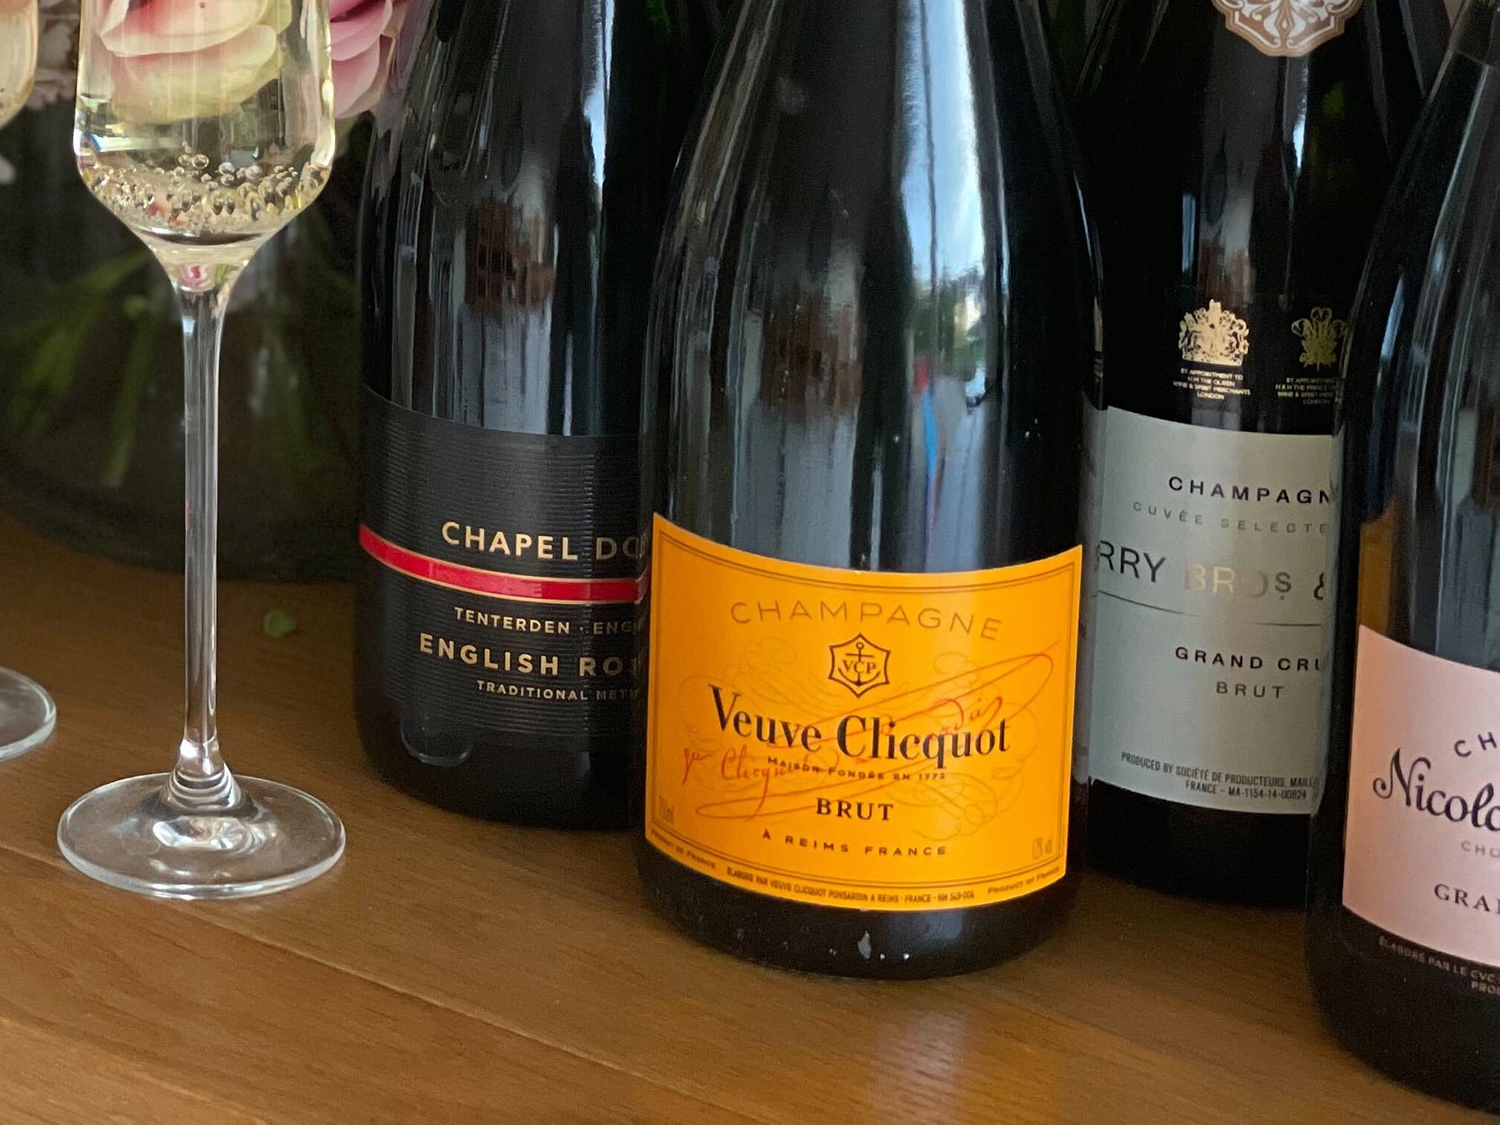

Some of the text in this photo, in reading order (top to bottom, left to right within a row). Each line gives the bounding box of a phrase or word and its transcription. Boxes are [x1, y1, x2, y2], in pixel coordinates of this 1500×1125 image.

[1168, 476, 1330, 504] CHAMPAGN
[1133, 501, 1203, 525] CUVÉE
[441, 521, 579, 561] CHAPEL
[454, 606, 570, 635] TENTERDEN
[730, 600, 1003, 641] CHAMPAGNE
[419, 632, 559, 676] ENGLISH
[1175, 646, 1263, 670] GRAND
[842, 659, 877, 675] VCP
[476, 679, 588, 701] TRADITIONAL
[1216, 681, 1285, 699] BRUT
[707, 683, 822, 753] Veuve
[836, 715, 1010, 769] Clicquot
[1453, 732, 1498, 758] CH
[767, 755, 820, 773] MAISON
[893, 772, 910, 780] EN
[918, 772, 946, 780] 1772
[1121, 751, 1161, 772] PRODUCED
[1163, 762, 1173, 773] BY
[1212, 771, 1223, 782] DE
[1225, 773, 1286, 788] PRODUCTEURS
[1185, 781, 1217, 795] FRANCE
[816, 797, 894, 821] BRUT
[785, 834, 849, 853] REIMS
[864, 845, 946, 856] FRANCE
[770, 878, 792, 893] VEUVE
[794, 884, 826, 897] CLICQUOT
[877, 893, 899, 903] REIMS
[904, 893, 931, 903] FRANCE
[1433, 882, 1500, 915] GRA
